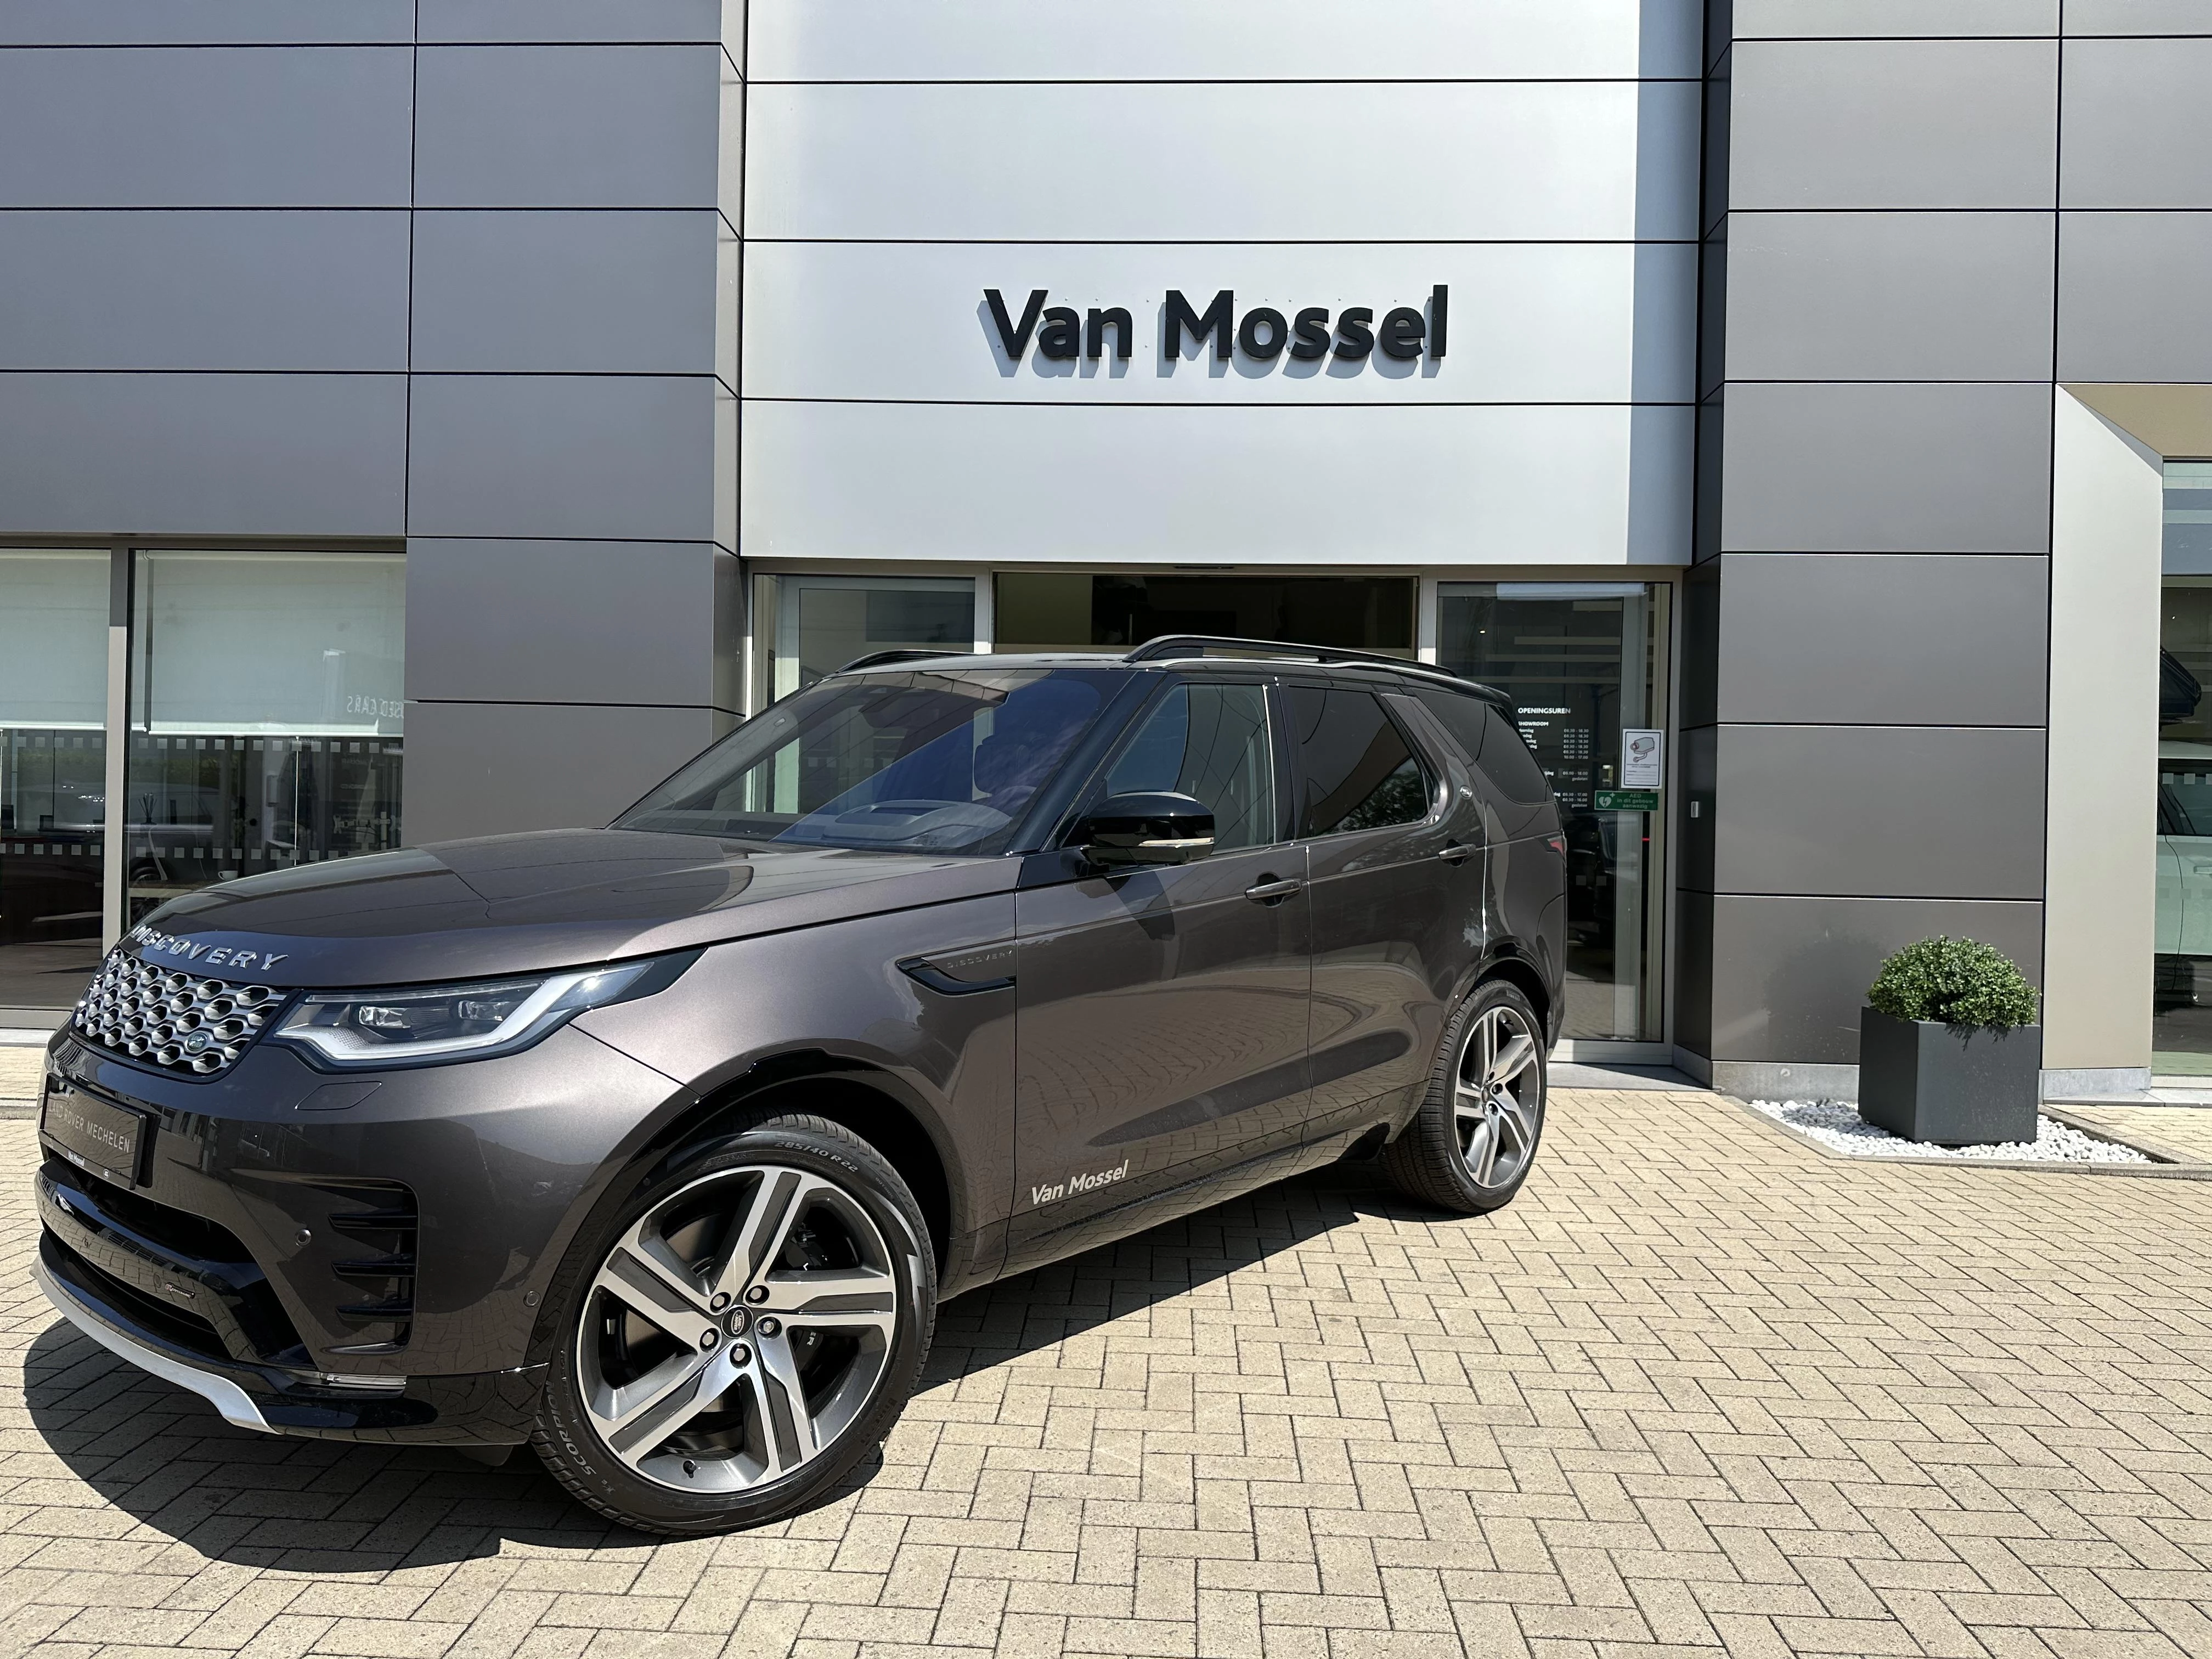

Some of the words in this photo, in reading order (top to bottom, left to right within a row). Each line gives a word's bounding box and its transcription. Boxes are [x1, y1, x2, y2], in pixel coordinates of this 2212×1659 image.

[983, 289, 1133, 358] Van
[1165, 284, 1448, 359] Mossel
[129, 923, 289, 970] DISCOVERY
[64, 1109, 84, 1131] ROVER
[86, 1121, 130, 1153] MECHELEN
[774, 1141, 829, 1156] 285/40
[1031, 1184, 1064, 1205] Van
[1068, 1159, 1129, 1195] Mossel
[545, 1381, 597, 1476] SCORPION
